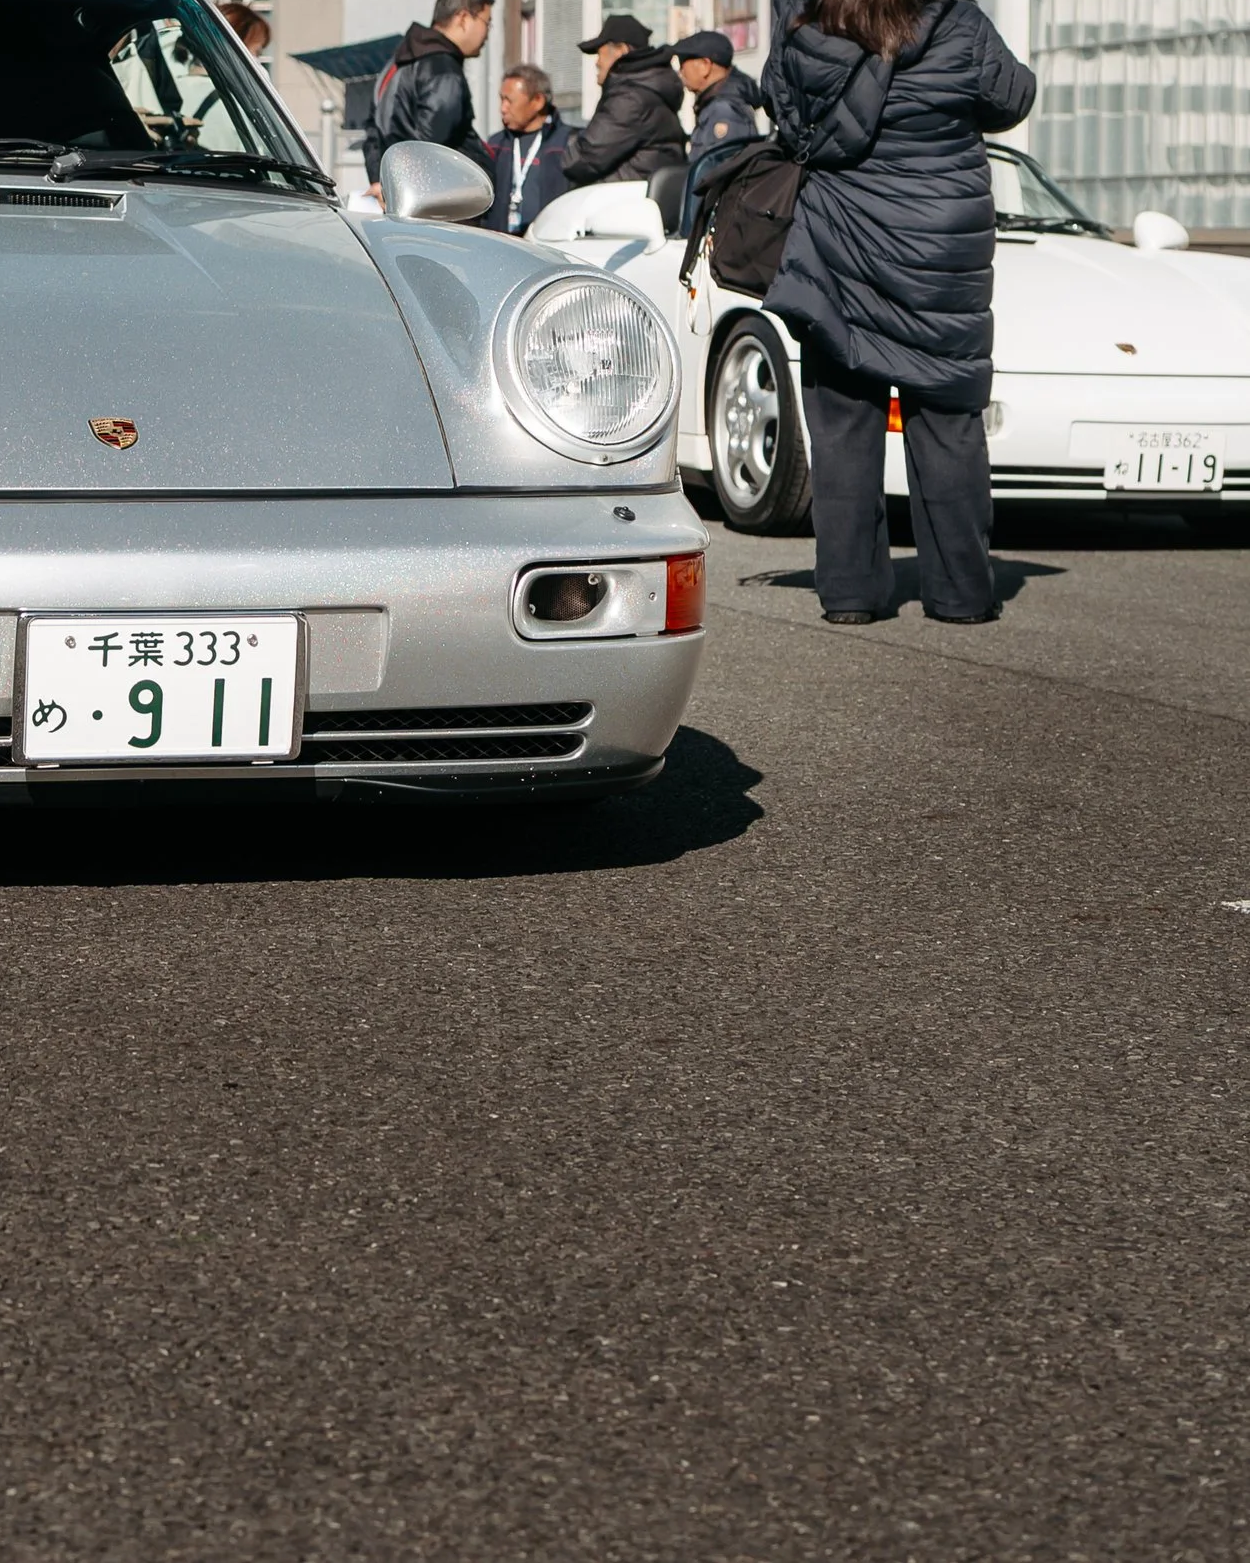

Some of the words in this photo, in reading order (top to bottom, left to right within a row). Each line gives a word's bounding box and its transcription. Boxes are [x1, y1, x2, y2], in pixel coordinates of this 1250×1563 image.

[1137, 453, 1217, 484] 11-19
[88, 632, 164, 667] 千葉
[173, 631, 240, 666] 333
[32, 698, 67, 733] め
